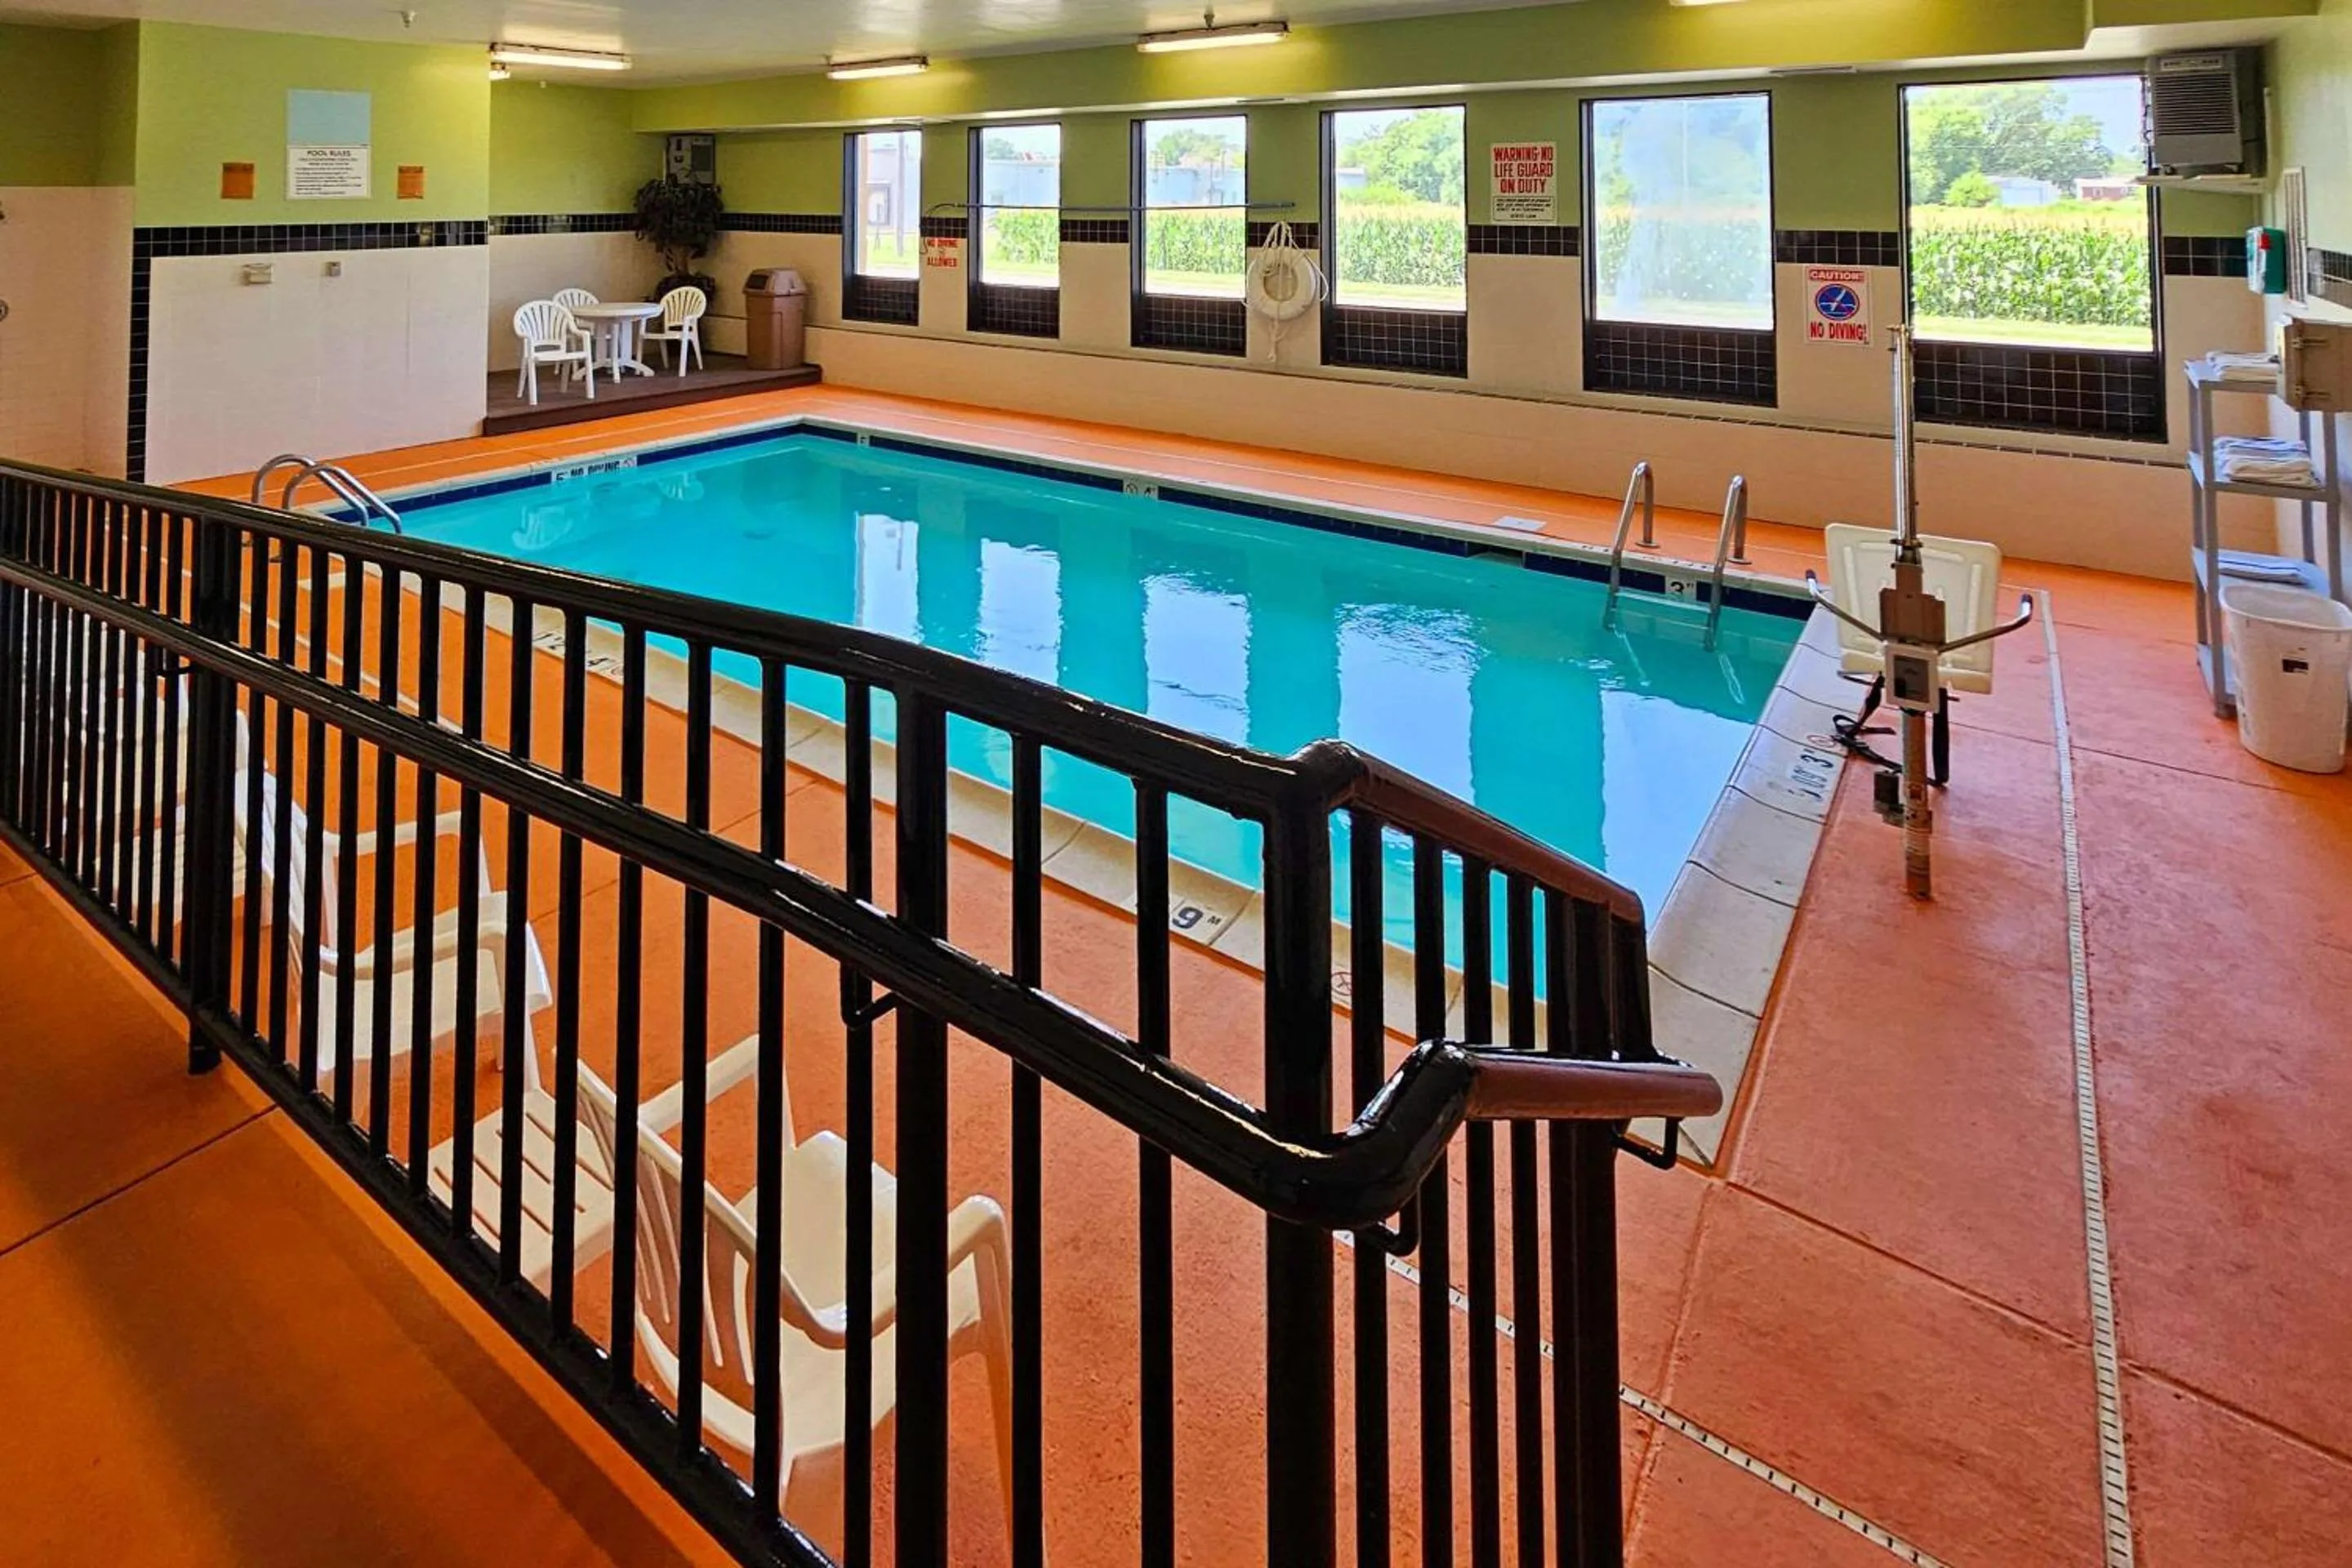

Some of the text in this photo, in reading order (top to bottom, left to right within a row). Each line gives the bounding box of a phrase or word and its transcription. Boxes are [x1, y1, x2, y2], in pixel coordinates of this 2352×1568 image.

[1494, 163, 1553, 178] LIFE GUARD
[1500, 179, 1546, 194] ON DUTY
[1811, 322, 1824, 338] NO
[1671, 581, 1685, 593] 3
[1172, 906, 1204, 929] 9
